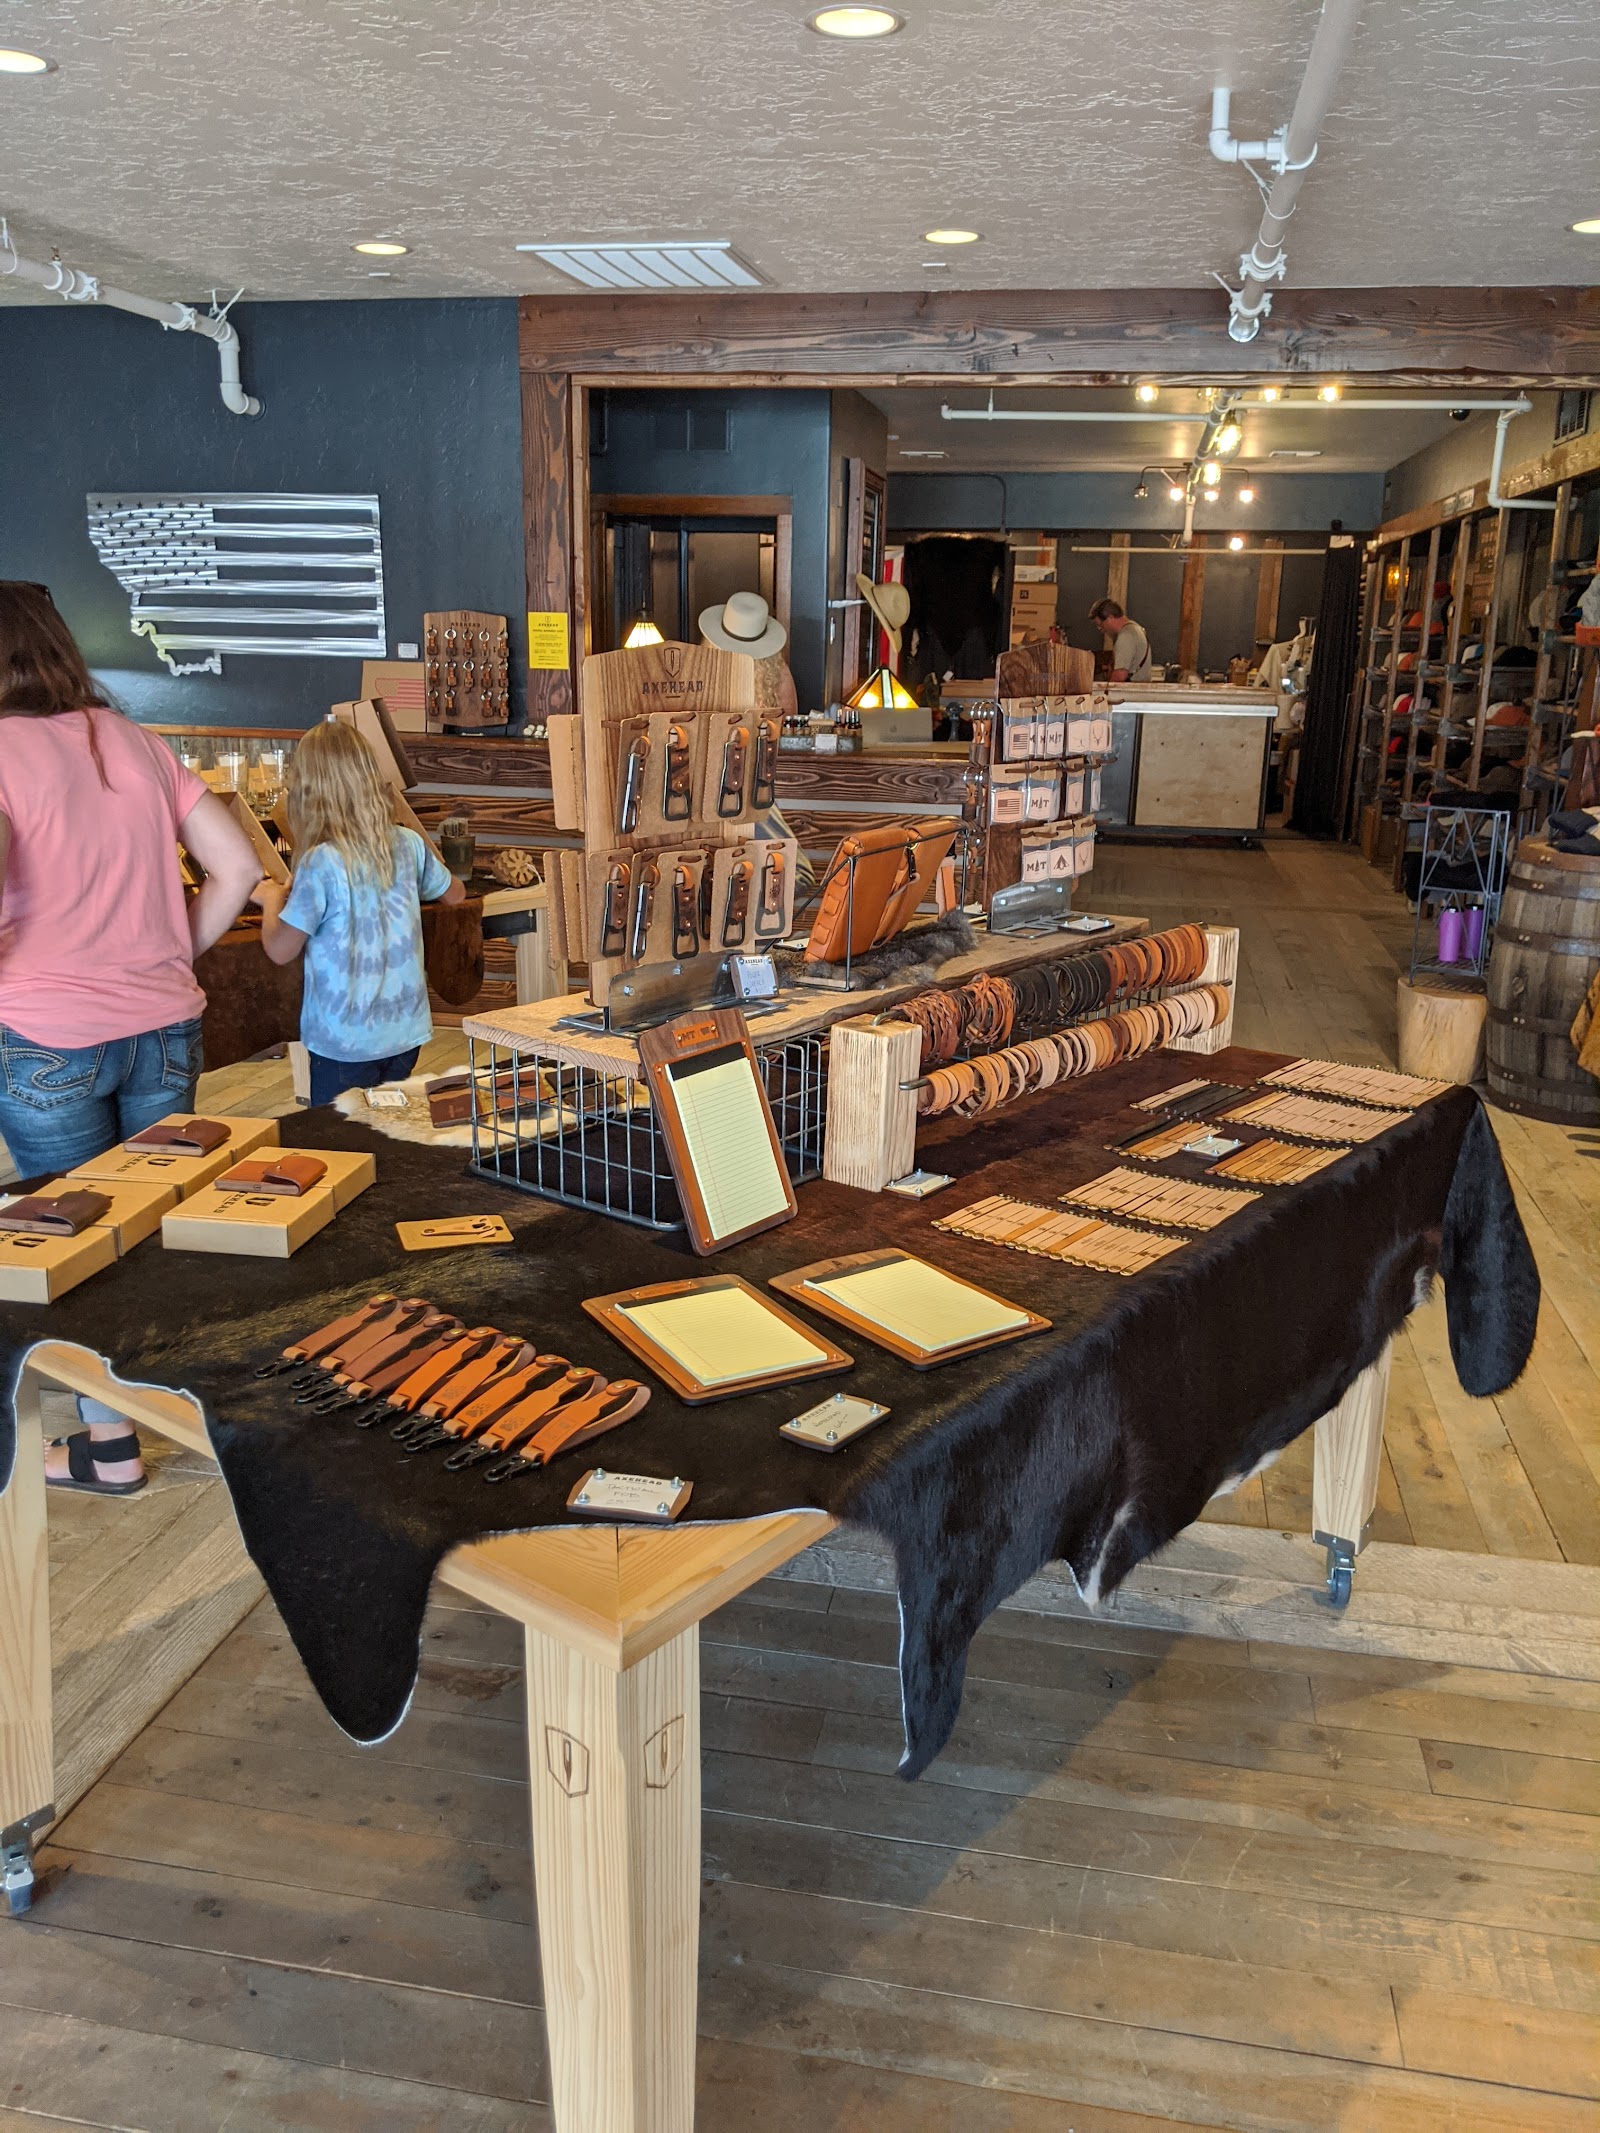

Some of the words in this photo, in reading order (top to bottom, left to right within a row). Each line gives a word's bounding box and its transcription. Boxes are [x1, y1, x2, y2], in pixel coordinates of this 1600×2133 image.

[642, 680, 704, 694] AXEHEAD
[213, 1191, 248, 1214] EHEAD
[614, 1476, 663, 1486] AXEHEAD
